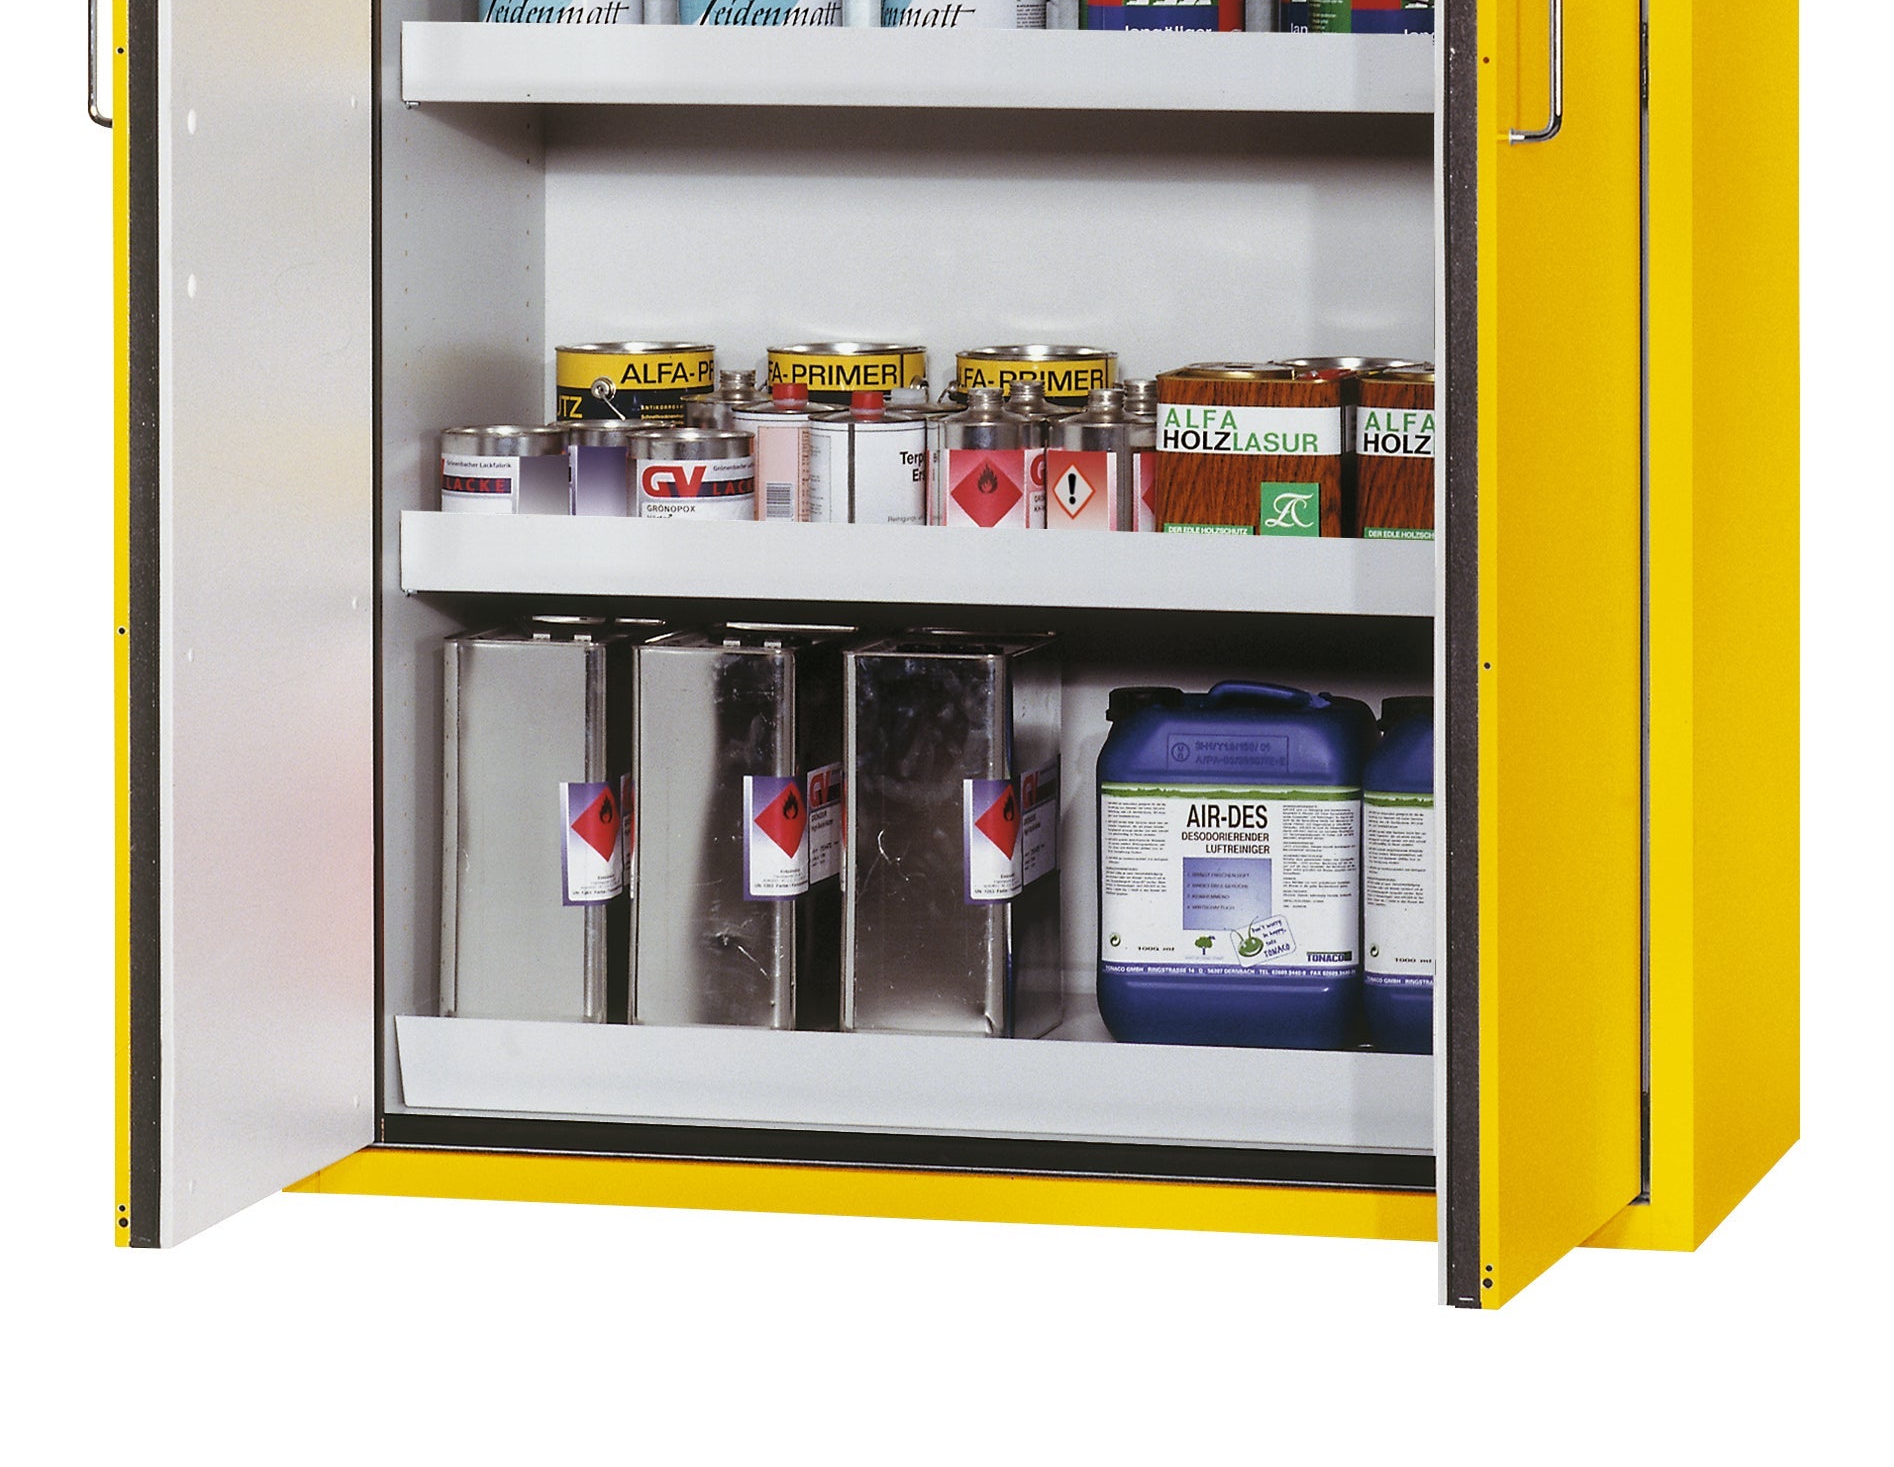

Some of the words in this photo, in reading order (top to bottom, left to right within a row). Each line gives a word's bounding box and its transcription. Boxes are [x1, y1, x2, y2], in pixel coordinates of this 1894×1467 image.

[1164, 407, 1238, 430] ALFA
[1364, 411, 1435, 433] ALFA
[1163, 429, 1319, 453] HOLZLASUR
[446, 477, 506, 494] LACKE
[642, 465, 707, 498] GV
[1183, 526, 1200, 534] EDLE
[1201, 527, 1248, 535] HOLZSCHUTZ
[1186, 803, 1269, 829] AIR-DES
[1181, 831, 1270, 842] DESODORIERENDER
[1205, 844, 1271, 855] LUFTREINIGER
[1263, 943, 1291, 958] TONACO
[1306, 954, 1346, 963] TONACO
